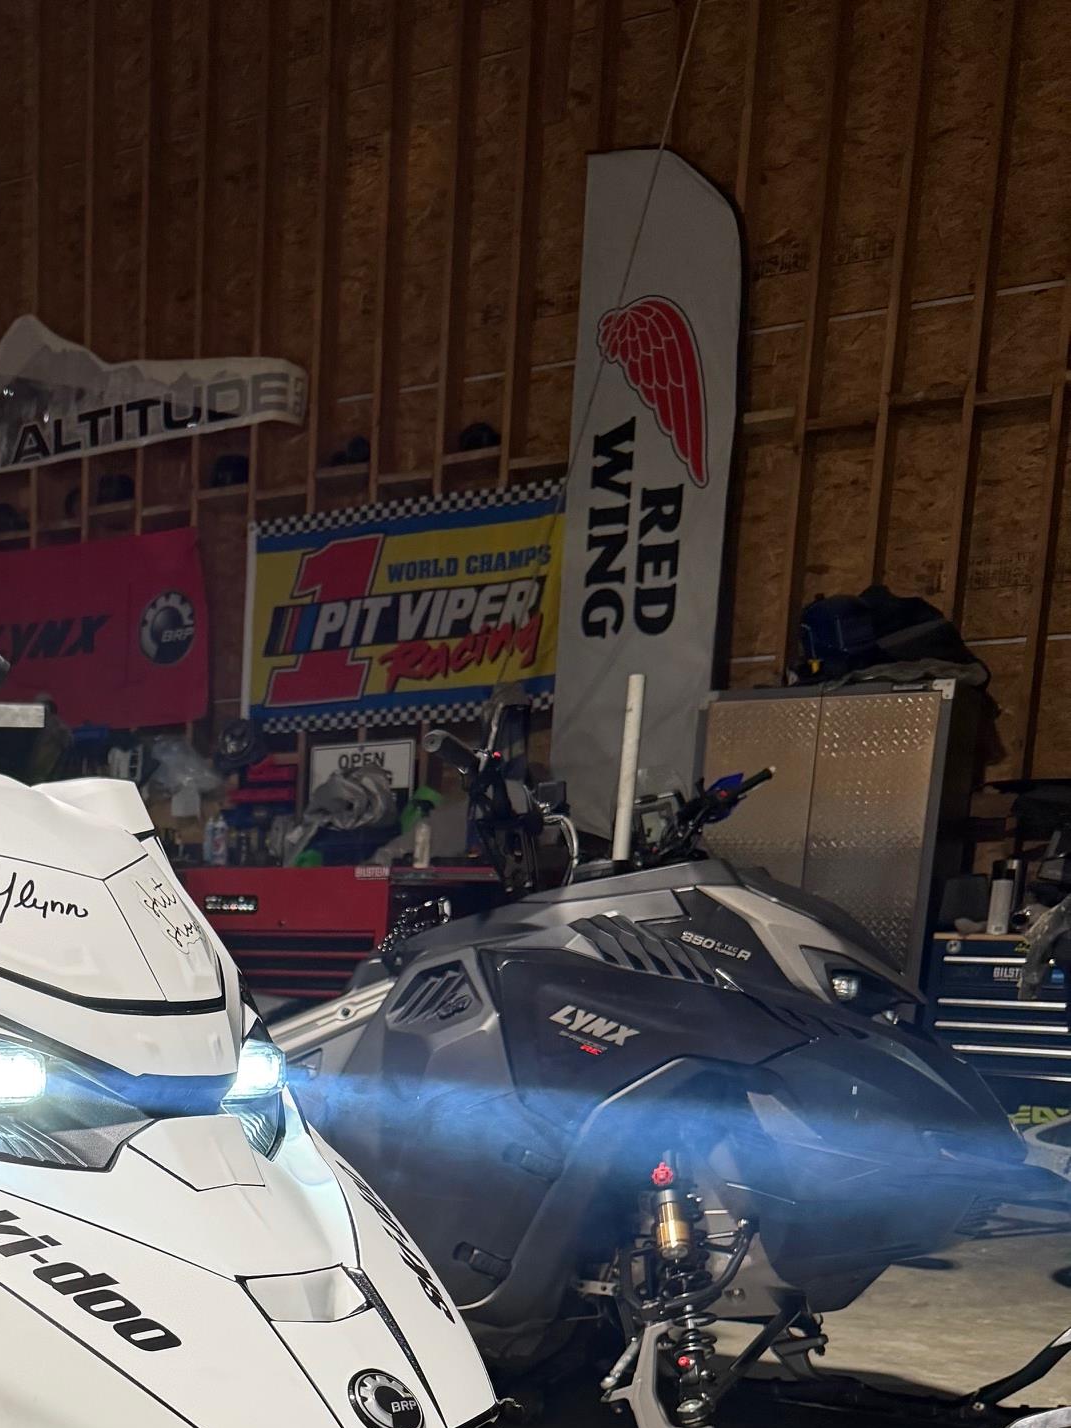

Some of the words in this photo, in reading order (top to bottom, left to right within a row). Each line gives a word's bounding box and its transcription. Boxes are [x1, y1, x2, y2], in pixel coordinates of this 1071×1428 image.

[11, 372, 290, 465] ALTITUDE
[581, 417, 636, 640] WING
[388, 557, 458, 583] WORLD
[466, 544, 551, 575] CHAMPS
[634, 484, 683, 636] RED
[310, 597, 392, 650] PIT
[397, 579, 541, 642] VIPER
[161, 629, 193, 643] BRP
[379, 612, 544, 691] Racing
[339, 751, 386, 770] OPEN
[680, 930, 716, 949] 850
[736, 949, 752, 961] R
[993, 966, 1022, 978] BILST
[548, 1004, 641, 1046] LYNX
[391, 1400, 417, 1413] BRP
